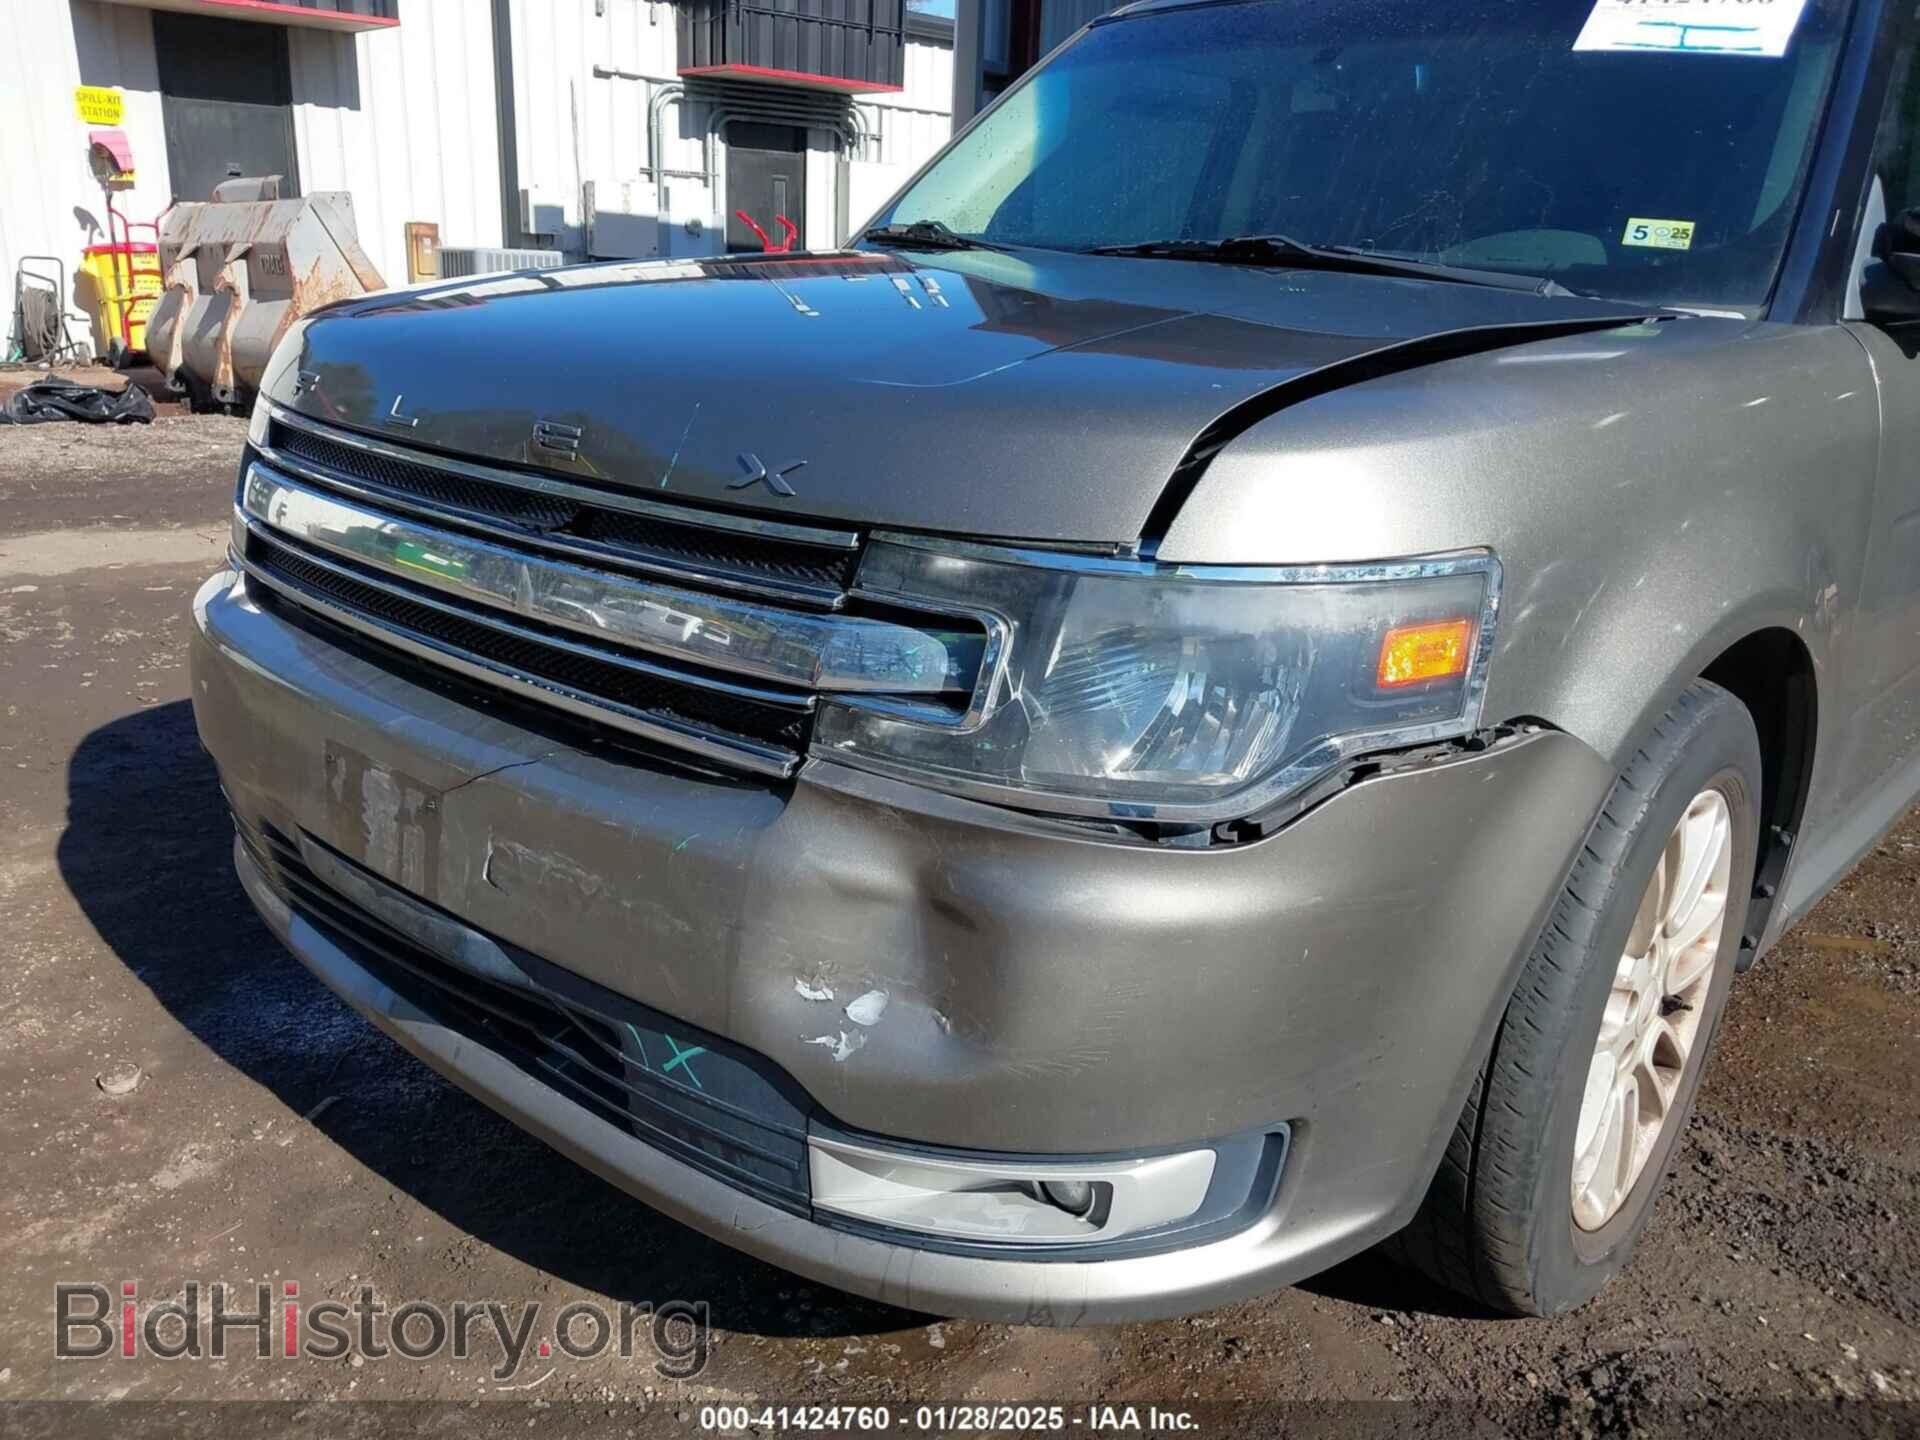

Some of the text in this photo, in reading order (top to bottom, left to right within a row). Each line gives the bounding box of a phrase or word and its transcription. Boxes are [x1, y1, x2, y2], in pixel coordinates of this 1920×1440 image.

[80, 106, 120, 119] STATION
[1632, 225, 1690, 240] 5 25
